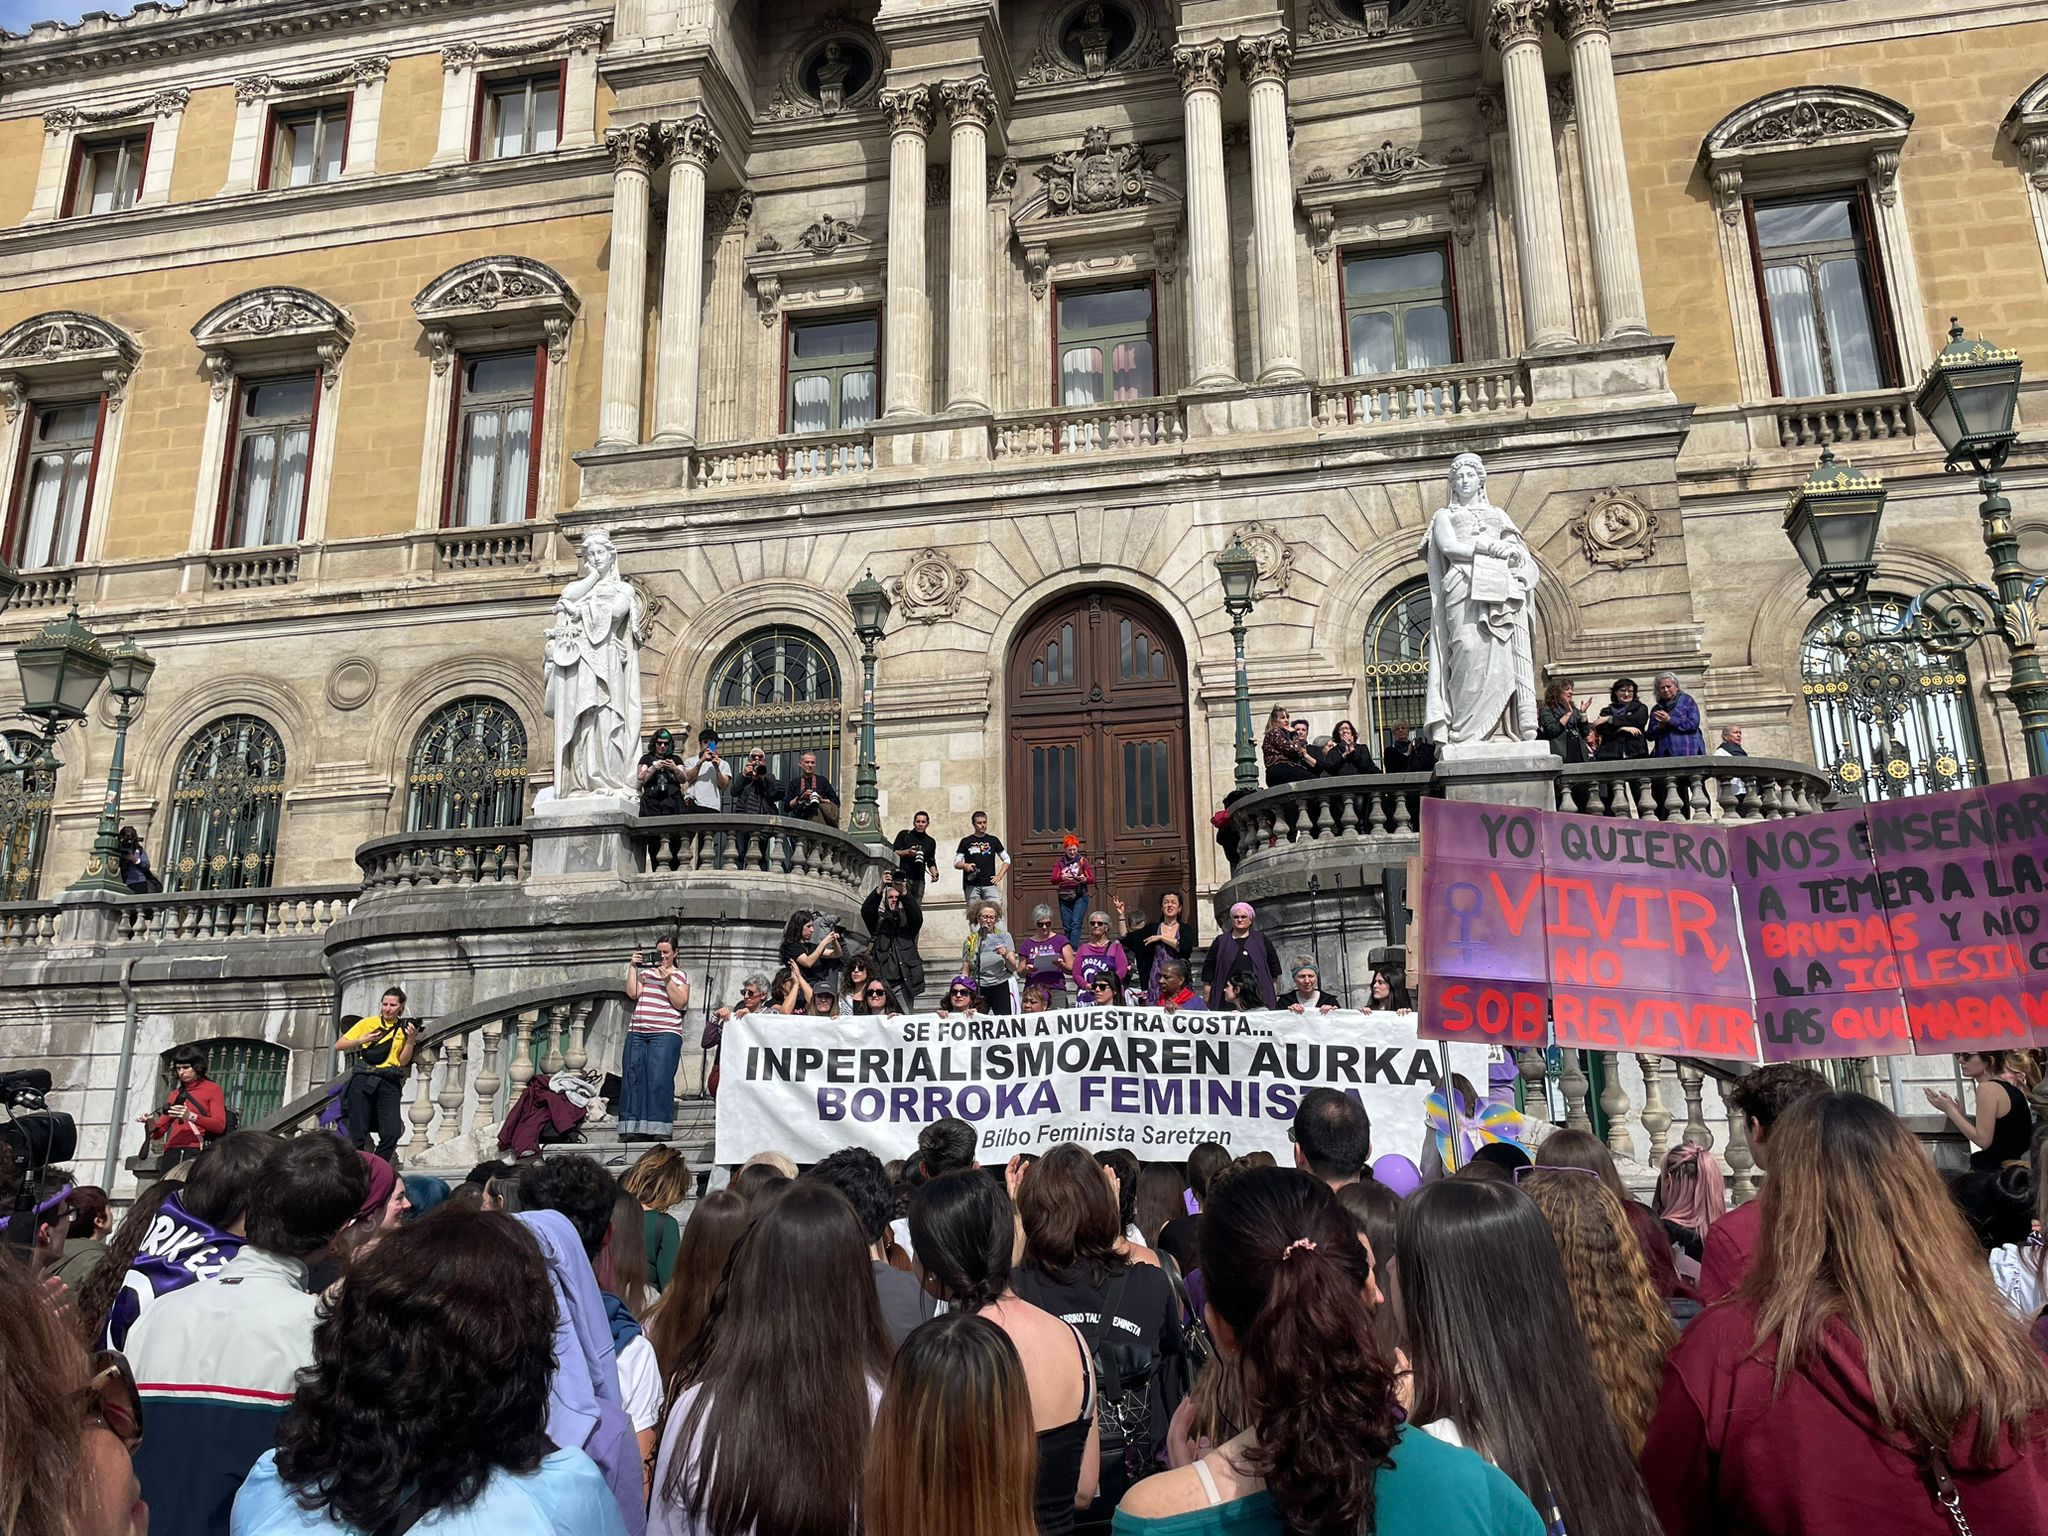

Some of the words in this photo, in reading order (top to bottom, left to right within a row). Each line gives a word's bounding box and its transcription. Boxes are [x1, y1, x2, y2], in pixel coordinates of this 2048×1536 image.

[1480, 813, 1535, 858] YO
[1561, 822, 1727, 878] QUIERO
[1747, 827, 1840, 878] NOS
[1759, 885, 1786, 921] A
[1799, 867, 1934, 914] TEMER
[1942, 862, 1975, 901] A
[1983, 854, 2048, 897] LA
[1489, 871, 1730, 974] VIVIR,
[1761, 912, 1919, 958] BRUJAS
[1940, 911, 1962, 941] Y
[1983, 905, 2040, 936] NO
[1554, 947, 1623, 988] NO
[1773, 960, 1833, 997] LA
[1837, 944, 2028, 993] IGLESIA
[902, 1021, 930, 1043] SE
[938, 1017, 1027, 1042] FORRAN
[1034, 1014, 1051, 1037] A
[1057, 1010, 1166, 1036] NUESTRA
[1172, 1014, 1274, 1037] COSTA...
[1440, 984, 1756, 1056] SOBREVIVIR
[1764, 1007, 1826, 1045] LAS
[745, 1037, 1231, 1084] INPERIALISMOAREN
[1248, 1043, 1439, 1086] AURKA
[816, 1079, 1062, 1123] BORROKA
[1079, 1076, 1366, 1121] FEMINIS
[982, 1129, 1031, 1149] Bilbo
[1037, 1122, 1135, 1145] Feminista
[1141, 1124, 1232, 1146] Saretzen
[1085, 1312, 1102, 1324] TAL
[1111, 1316, 1141, 1337] EMINISTA
